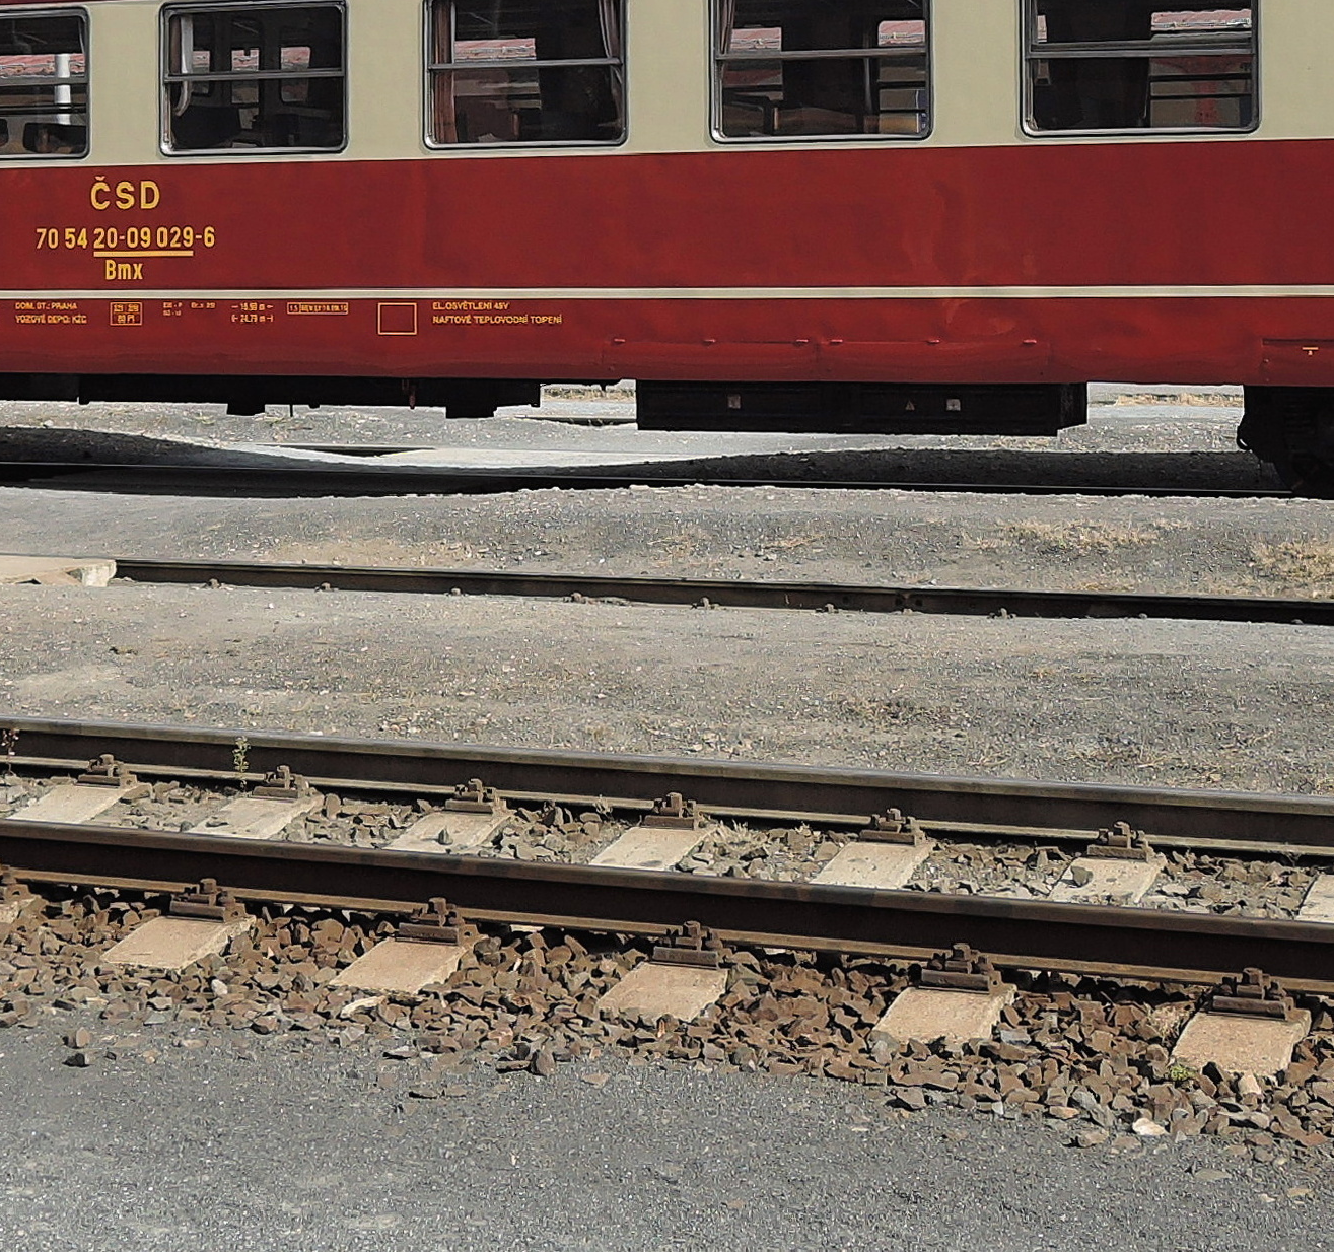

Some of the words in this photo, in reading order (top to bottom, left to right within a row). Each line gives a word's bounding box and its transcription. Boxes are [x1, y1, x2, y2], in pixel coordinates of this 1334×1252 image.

[90, 176, 161, 210] ČSD
[36, 228, 59, 249] 70
[64, 227, 88, 249] 54
[93, 227, 151, 249] 20-09
[156, 226, 215, 248] 029-6
[105, 259, 144, 280] Bmx
